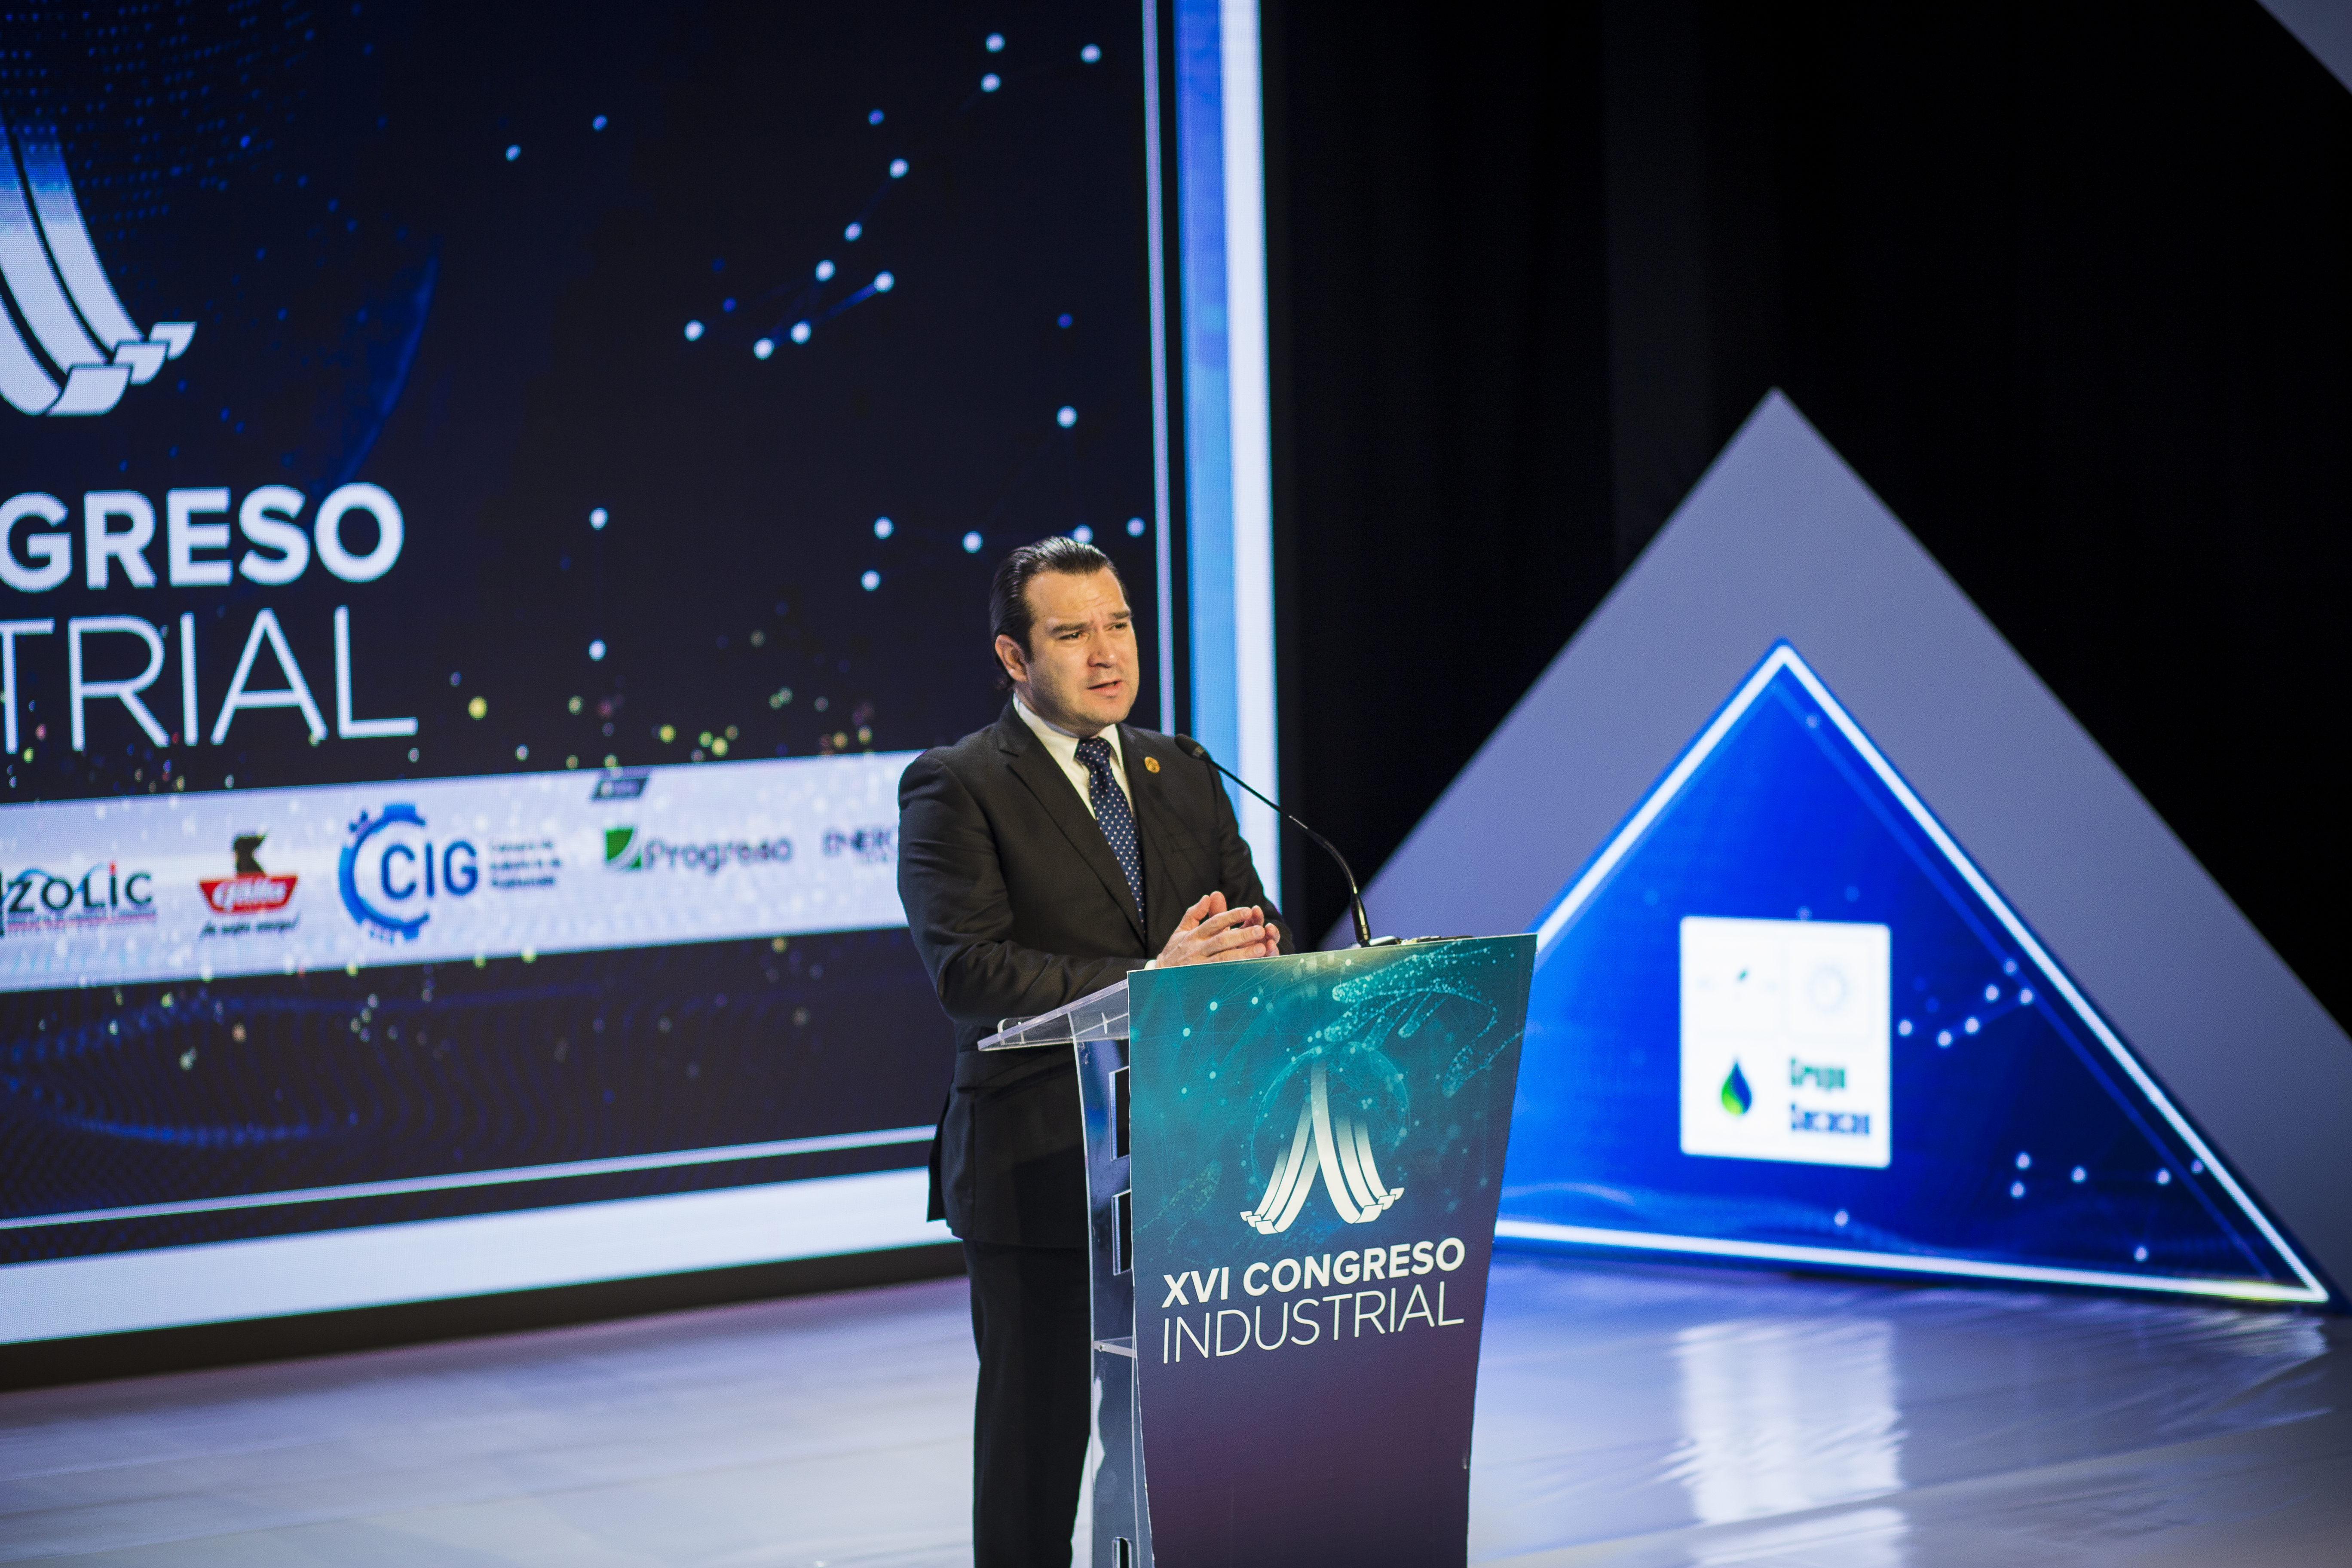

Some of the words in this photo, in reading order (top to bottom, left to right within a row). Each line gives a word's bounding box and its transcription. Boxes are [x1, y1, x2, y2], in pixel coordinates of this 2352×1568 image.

[0, 482, 404, 594] GRESO
[381, 840, 478, 899] CIG
[1161, 1266, 1229, 1308] XVI
[1243, 1237, 1465, 1296] CONGRESO
[1163, 1281, 1464, 1364] INDUSTRIAL
